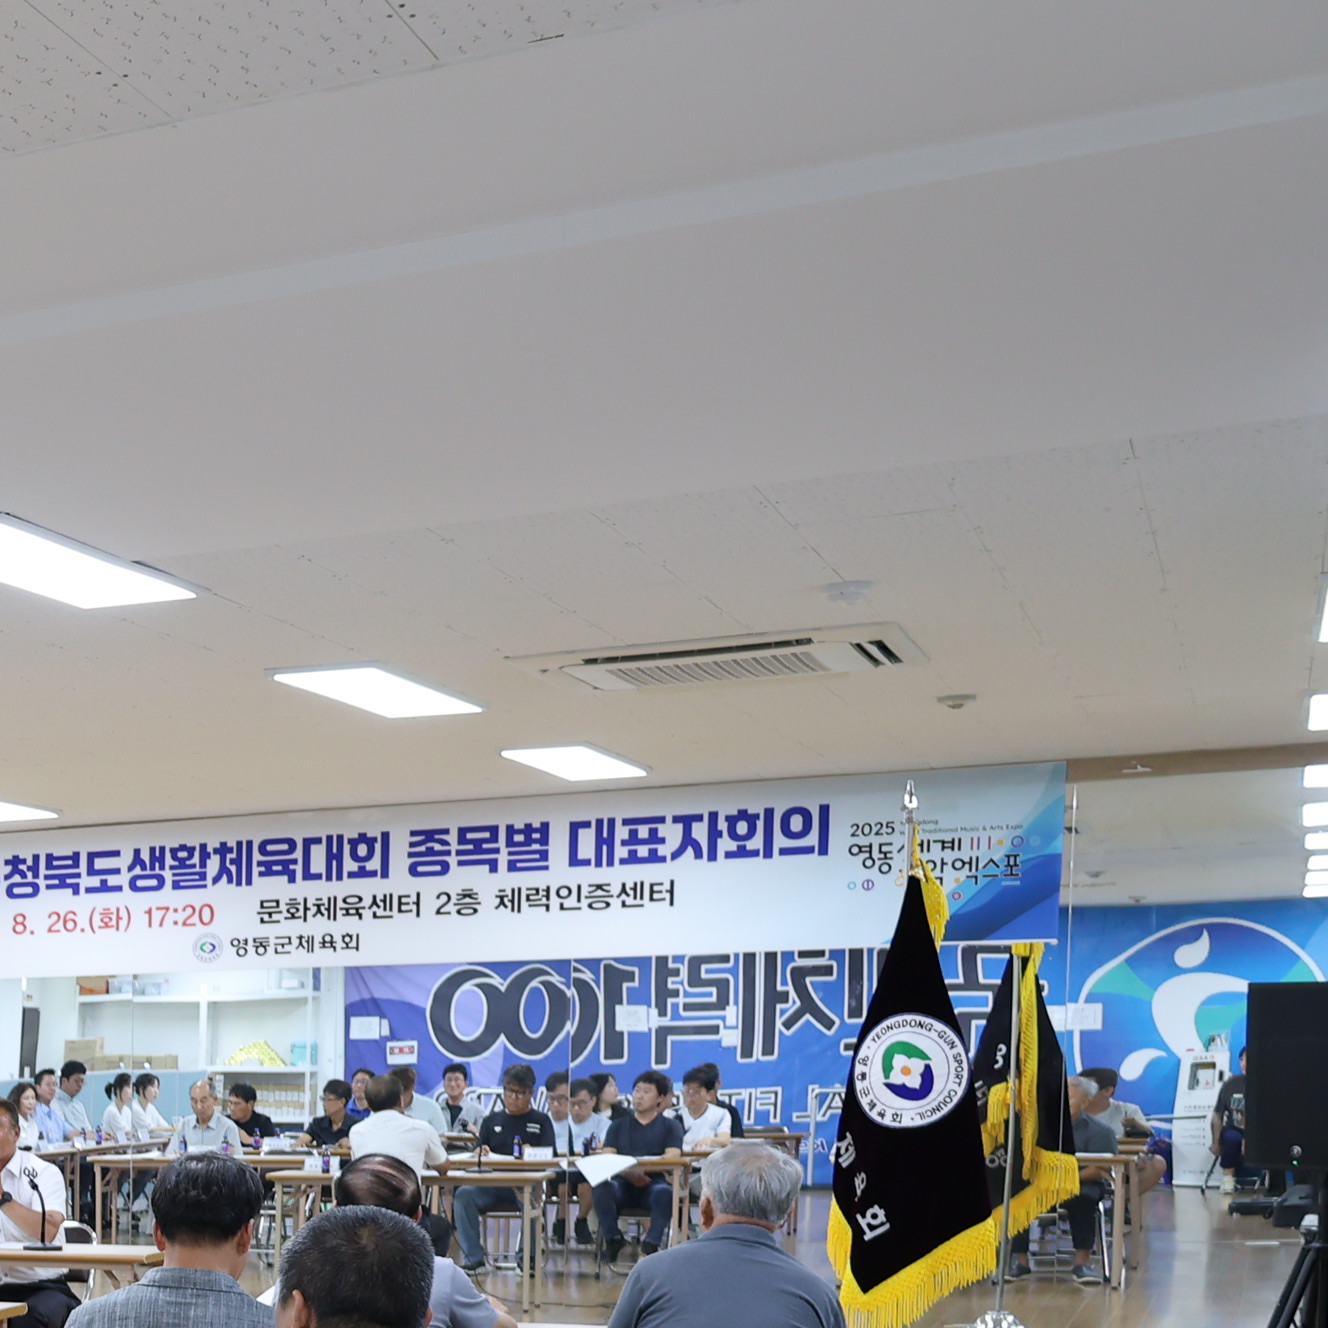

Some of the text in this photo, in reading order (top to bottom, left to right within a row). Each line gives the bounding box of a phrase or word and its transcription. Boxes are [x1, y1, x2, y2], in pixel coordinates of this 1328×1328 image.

[406, 820, 550, 879] 종목별
[568, 803, 831, 869] 대표자회의
[850, 821, 895, 837] 2025
[960, 824, 980, 832] Music
[989, 823, 1004, 831] Arts
[1006, 823, 1024, 831] Expo
[12, 912, 35, 936] 8.
[47, 905, 131, 934] 26.(화)
[143, 903, 216, 928] 17:20
[256, 891, 422, 925] 문화체육센터
[434, 888, 482, 917] 2층
[494, 879, 676, 914] 체력인증센터
[229, 931, 361, 957] 영동군체육회
[856, 1055, 904, 1124] 영동군체육회
[871, 1018, 965, 1121] YEONGDONG-GUN SPORT COUNCIL
